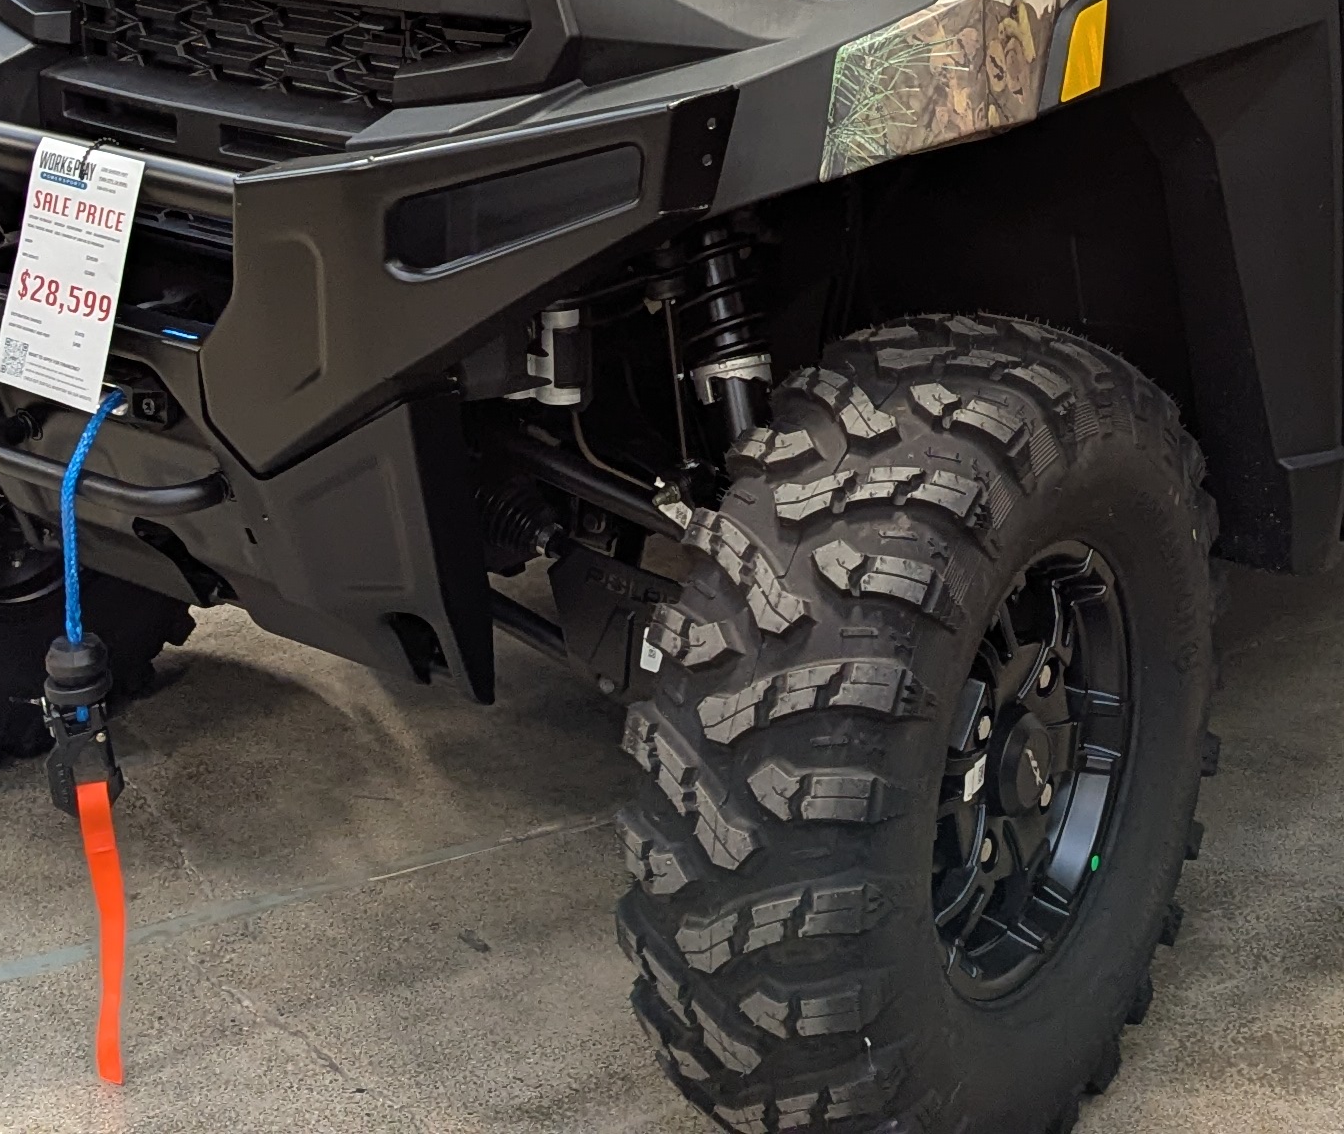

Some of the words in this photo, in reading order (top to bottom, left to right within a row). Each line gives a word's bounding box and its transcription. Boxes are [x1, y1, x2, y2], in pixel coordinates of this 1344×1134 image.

[32, 189, 72, 218] SALE
[75, 200, 127, 233] PRICE
[17, 268, 113, 323] $28,599
